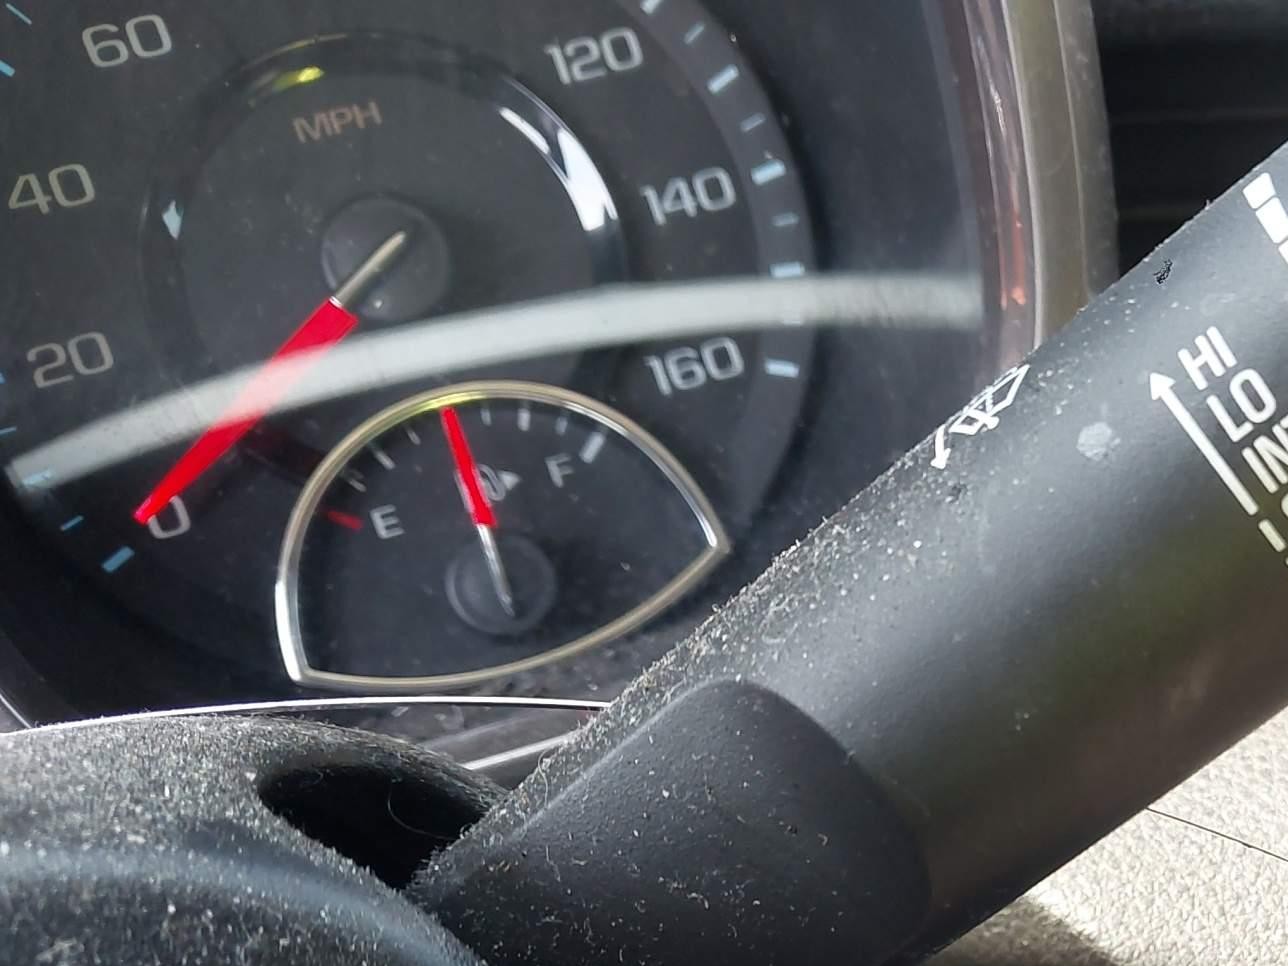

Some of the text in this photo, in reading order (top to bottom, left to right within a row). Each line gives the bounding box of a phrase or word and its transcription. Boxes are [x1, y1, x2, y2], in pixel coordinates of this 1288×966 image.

[81, 14, 172, 67] 60
[544, 28, 644, 85] 120
[293, 101, 383, 144] MPH
[8, 164, 95, 215] 40
[643, 167, 737, 225] 140
[26, 332, 115, 389] 20
[646, 336, 745, 396] 160
[1179, 326, 1237, 390] HI
[1207, 369, 1277, 443] LO
[545, 453, 574, 488] F
[369, 504, 405, 540] E
